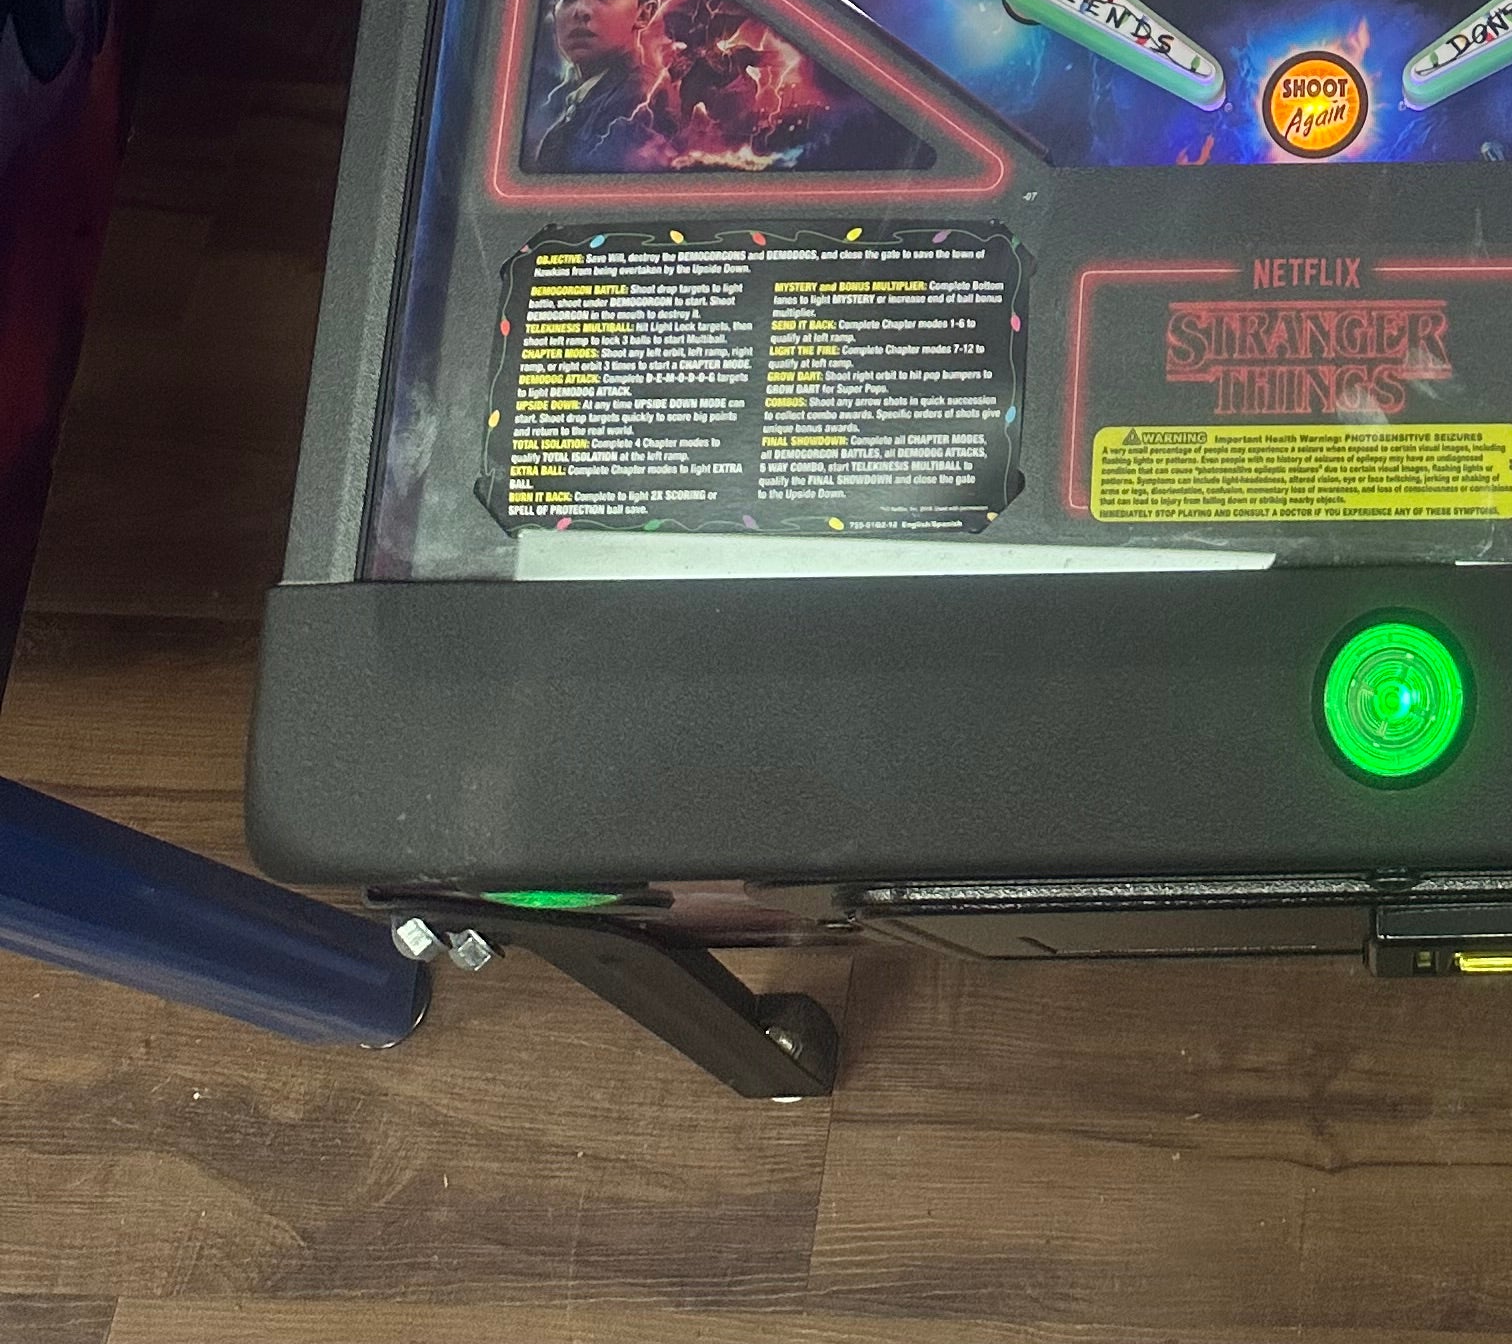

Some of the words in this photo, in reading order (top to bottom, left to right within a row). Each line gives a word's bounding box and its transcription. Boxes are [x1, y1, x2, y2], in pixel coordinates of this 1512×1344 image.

[1282, 78, 1349, 100] SHOOT
[1285, 100, 1347, 140] Again
[1253, 257, 1361, 290] NETFLIX
[531, 285, 592, 297] DEMOGORGON
[594, 284, 629, 295] BATTLE:
[630, 284, 656, 295] Shoot
[657, 284, 677, 295] drop
[679, 284, 710, 295] targets
[722, 283, 743, 294] light
[525, 323, 581, 334] TELEKINESIS
[582, 322, 634, 333] MULTIBALL:
[771, 319, 796, 330] SEND
[808, 319, 836, 330] BACK:
[838, 319, 880, 331] Complete
[882, 319, 916, 331] Chapter
[918, 318, 948, 329] modes
[950, 318, 965, 329] 1-6
[1166, 307, 1453, 372] STRANGER
[1213, 364, 1407, 415] THINGS
[761, 436, 787, 447] FINAL
[790, 435, 848, 446] SHOWDOWN:
[850, 435, 892, 447] Complete
[907, 434, 949, 445] CHAPTER
[1141, 431, 1208, 445] WARNING
[1215, 434, 1263, 445] Important
[1265, 434, 1297, 444] Health
[1300, 433, 1343, 445] Warning:
[1344, 432, 1431, 443] PHOTOSENSITIVE
[1433, 432, 1483, 442] SEIZURES
